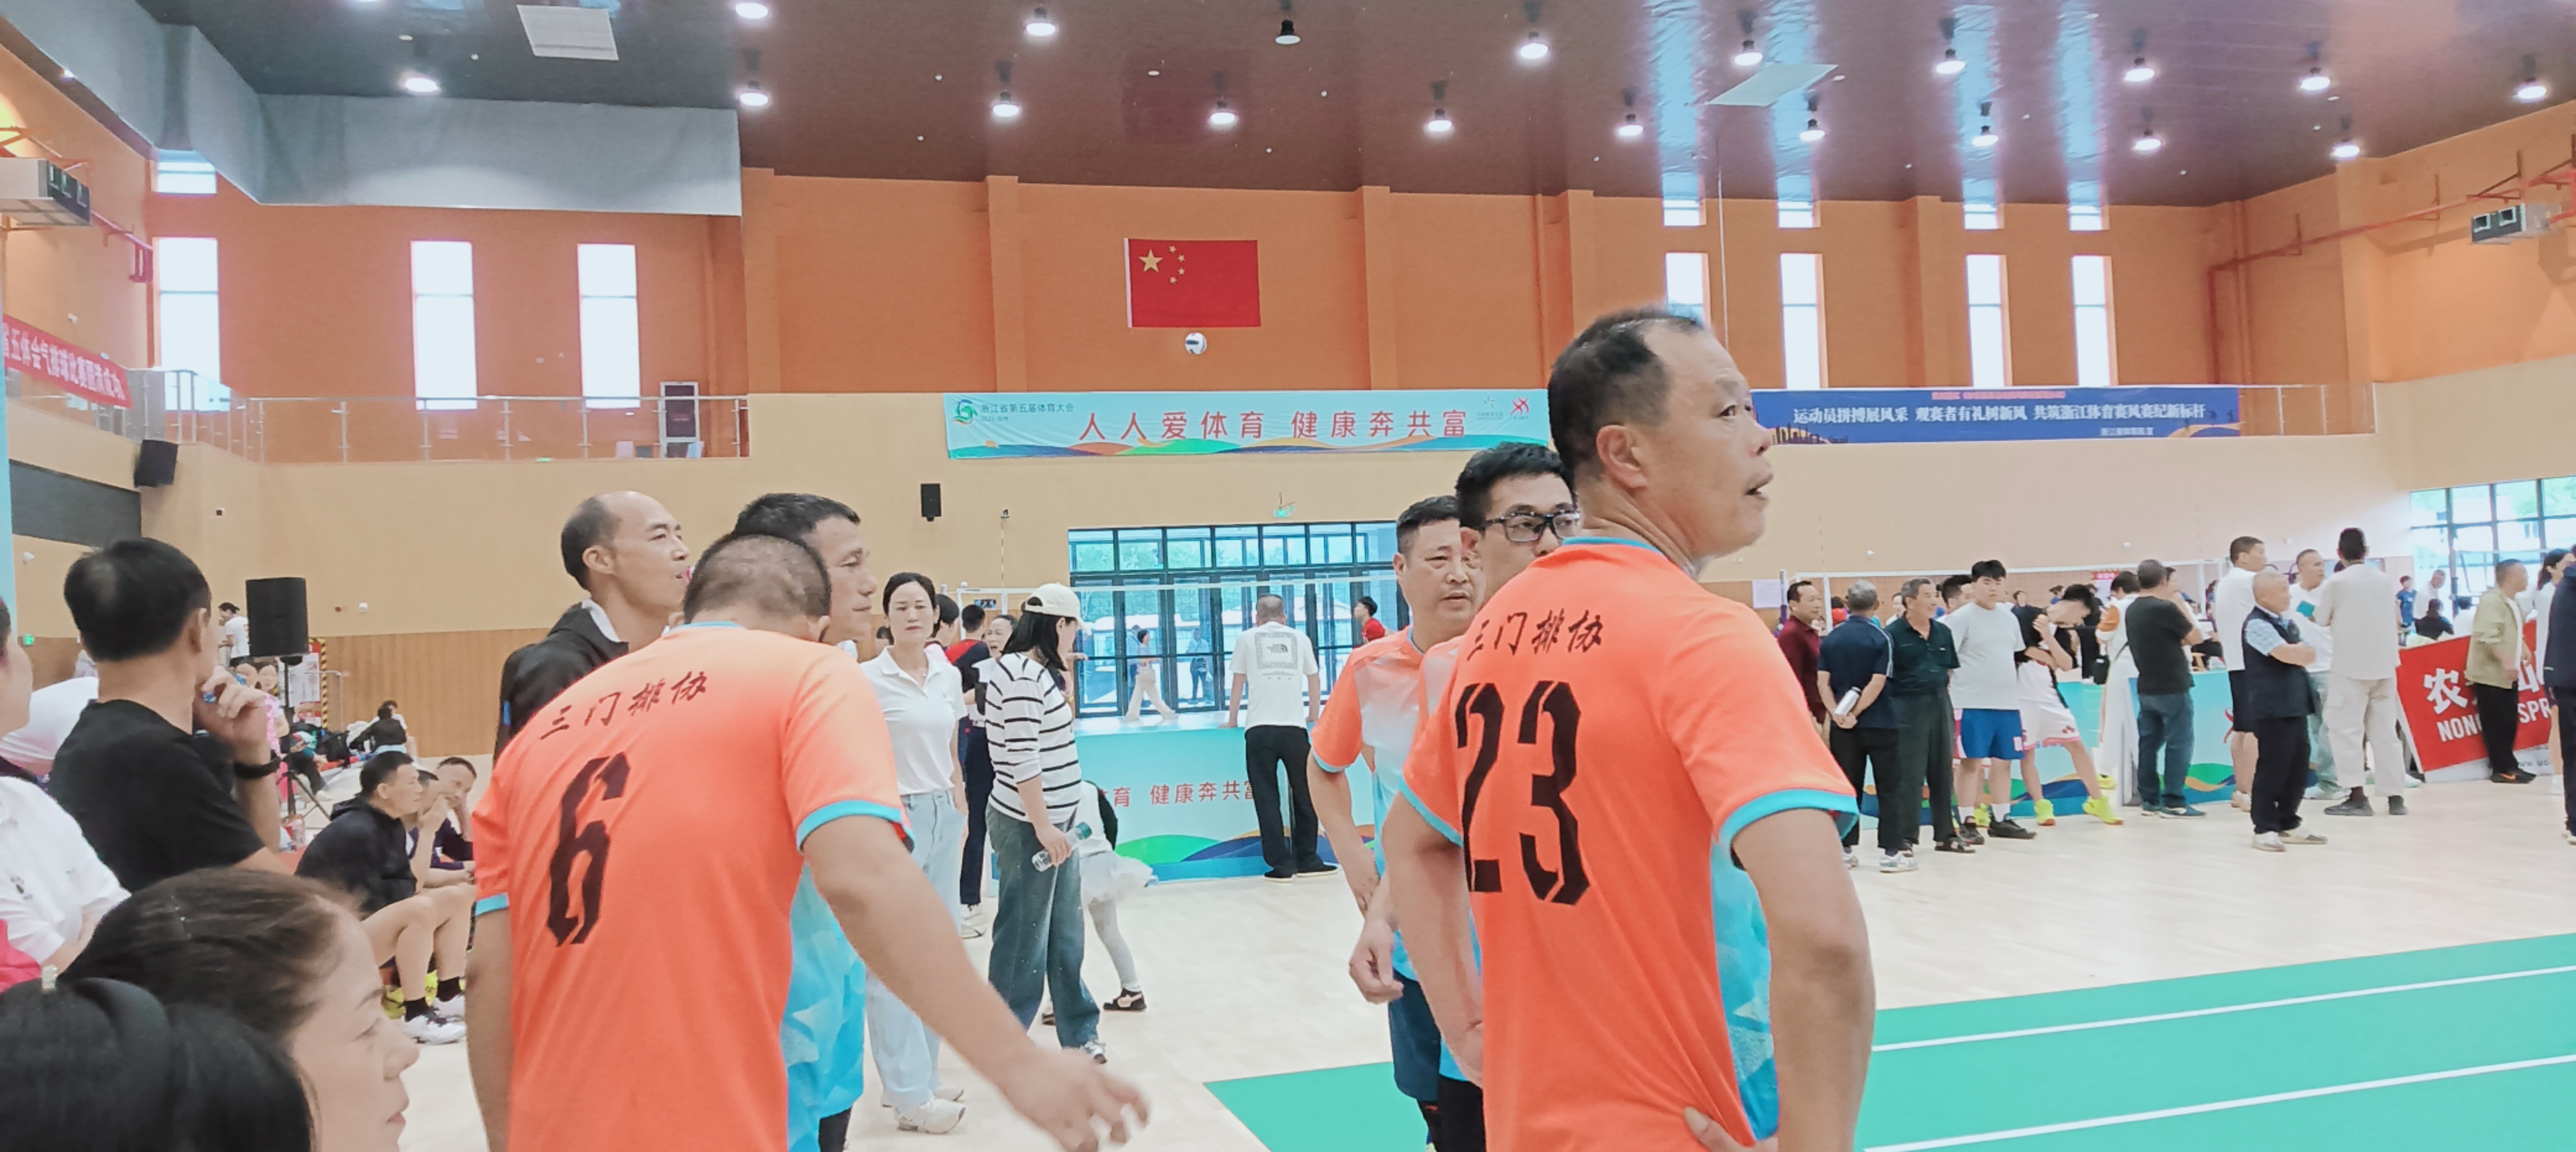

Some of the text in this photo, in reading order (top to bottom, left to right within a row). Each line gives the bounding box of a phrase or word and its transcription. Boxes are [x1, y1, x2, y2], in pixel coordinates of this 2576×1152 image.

[980, 403, 1074, 414] 浙江省第五届体育大会
[1079, 409, 1466, 440] 人人爱体育 健康奔共富
[1793, 406, 1909, 424] 运动员拼搏展风采
[1915, 404, 2028, 422] 观赛者有礼树新风
[1466, 608, 1604, 661] 三门排协
[541, 671, 708, 740] 三门排协
[1455, 680, 1591, 905] 23
[546, 751, 631, 948] 6
